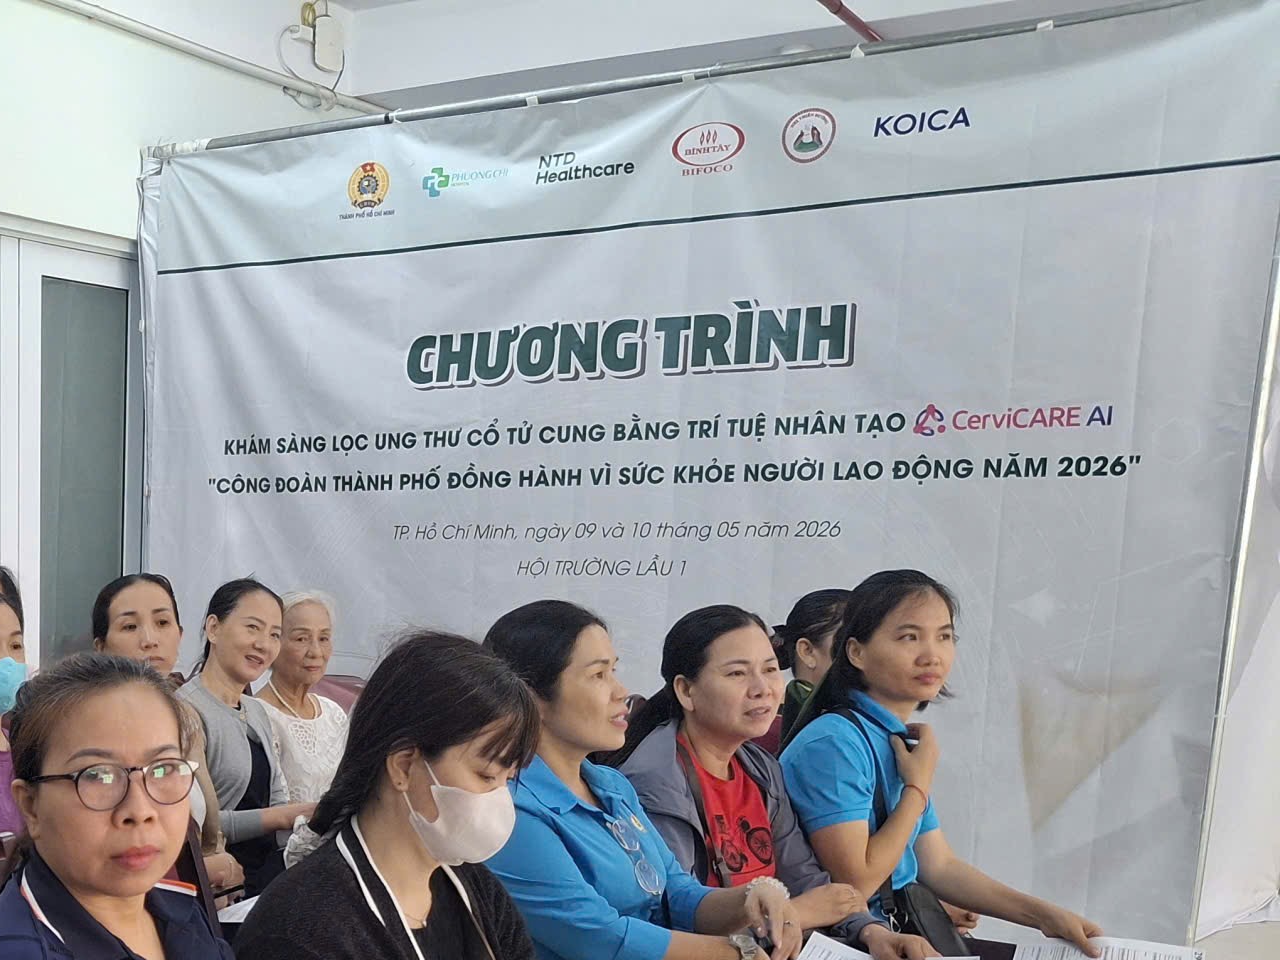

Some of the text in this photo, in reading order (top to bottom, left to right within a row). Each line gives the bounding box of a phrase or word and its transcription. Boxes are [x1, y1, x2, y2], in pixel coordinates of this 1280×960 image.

[873, 107, 971, 137] KOICA
[539, 151, 576, 169] NTD
[682, 164, 733, 177] BIFOCO
[535, 161, 635, 185] Healthcare
[406, 299, 856, 392] CHƯƠNG TRÌNH
[225, 406, 1112, 456] KHÁM SÀNG LỌC UNG THƯ CỔ TỬ CUNG BẰNG TRÍ TUỆ NHÂN TẠO CerviCARE AI
[275, 472, 326, 493] ĐOÀN
[333, 470, 392, 491] THÀNH
[400, 465, 441, 490] PHỐ
[447, 463, 511, 489] ĐỒNG
[519, 465, 581, 487] HÀNH
[590, 463, 611, 485] VÌ
[619, 461, 664, 485] SỨC
[673, 457, 735, 485] KHỎE
[744, 457, 824, 482] NGƯỜI
[834, 461, 883, 480] LAO
[892, 454, 973, 485] ĐỘNG
[984, 453, 1047, 478] NĂM
[1058, 455, 1141, 476] 2026"
[394, 521, 841, 542] TP. Hồ Chí Minh, ngày 09 và 10 tháng 05 năm 2026
[517, 554, 687, 579] HỘI TRƯỜNG LẦU 1
